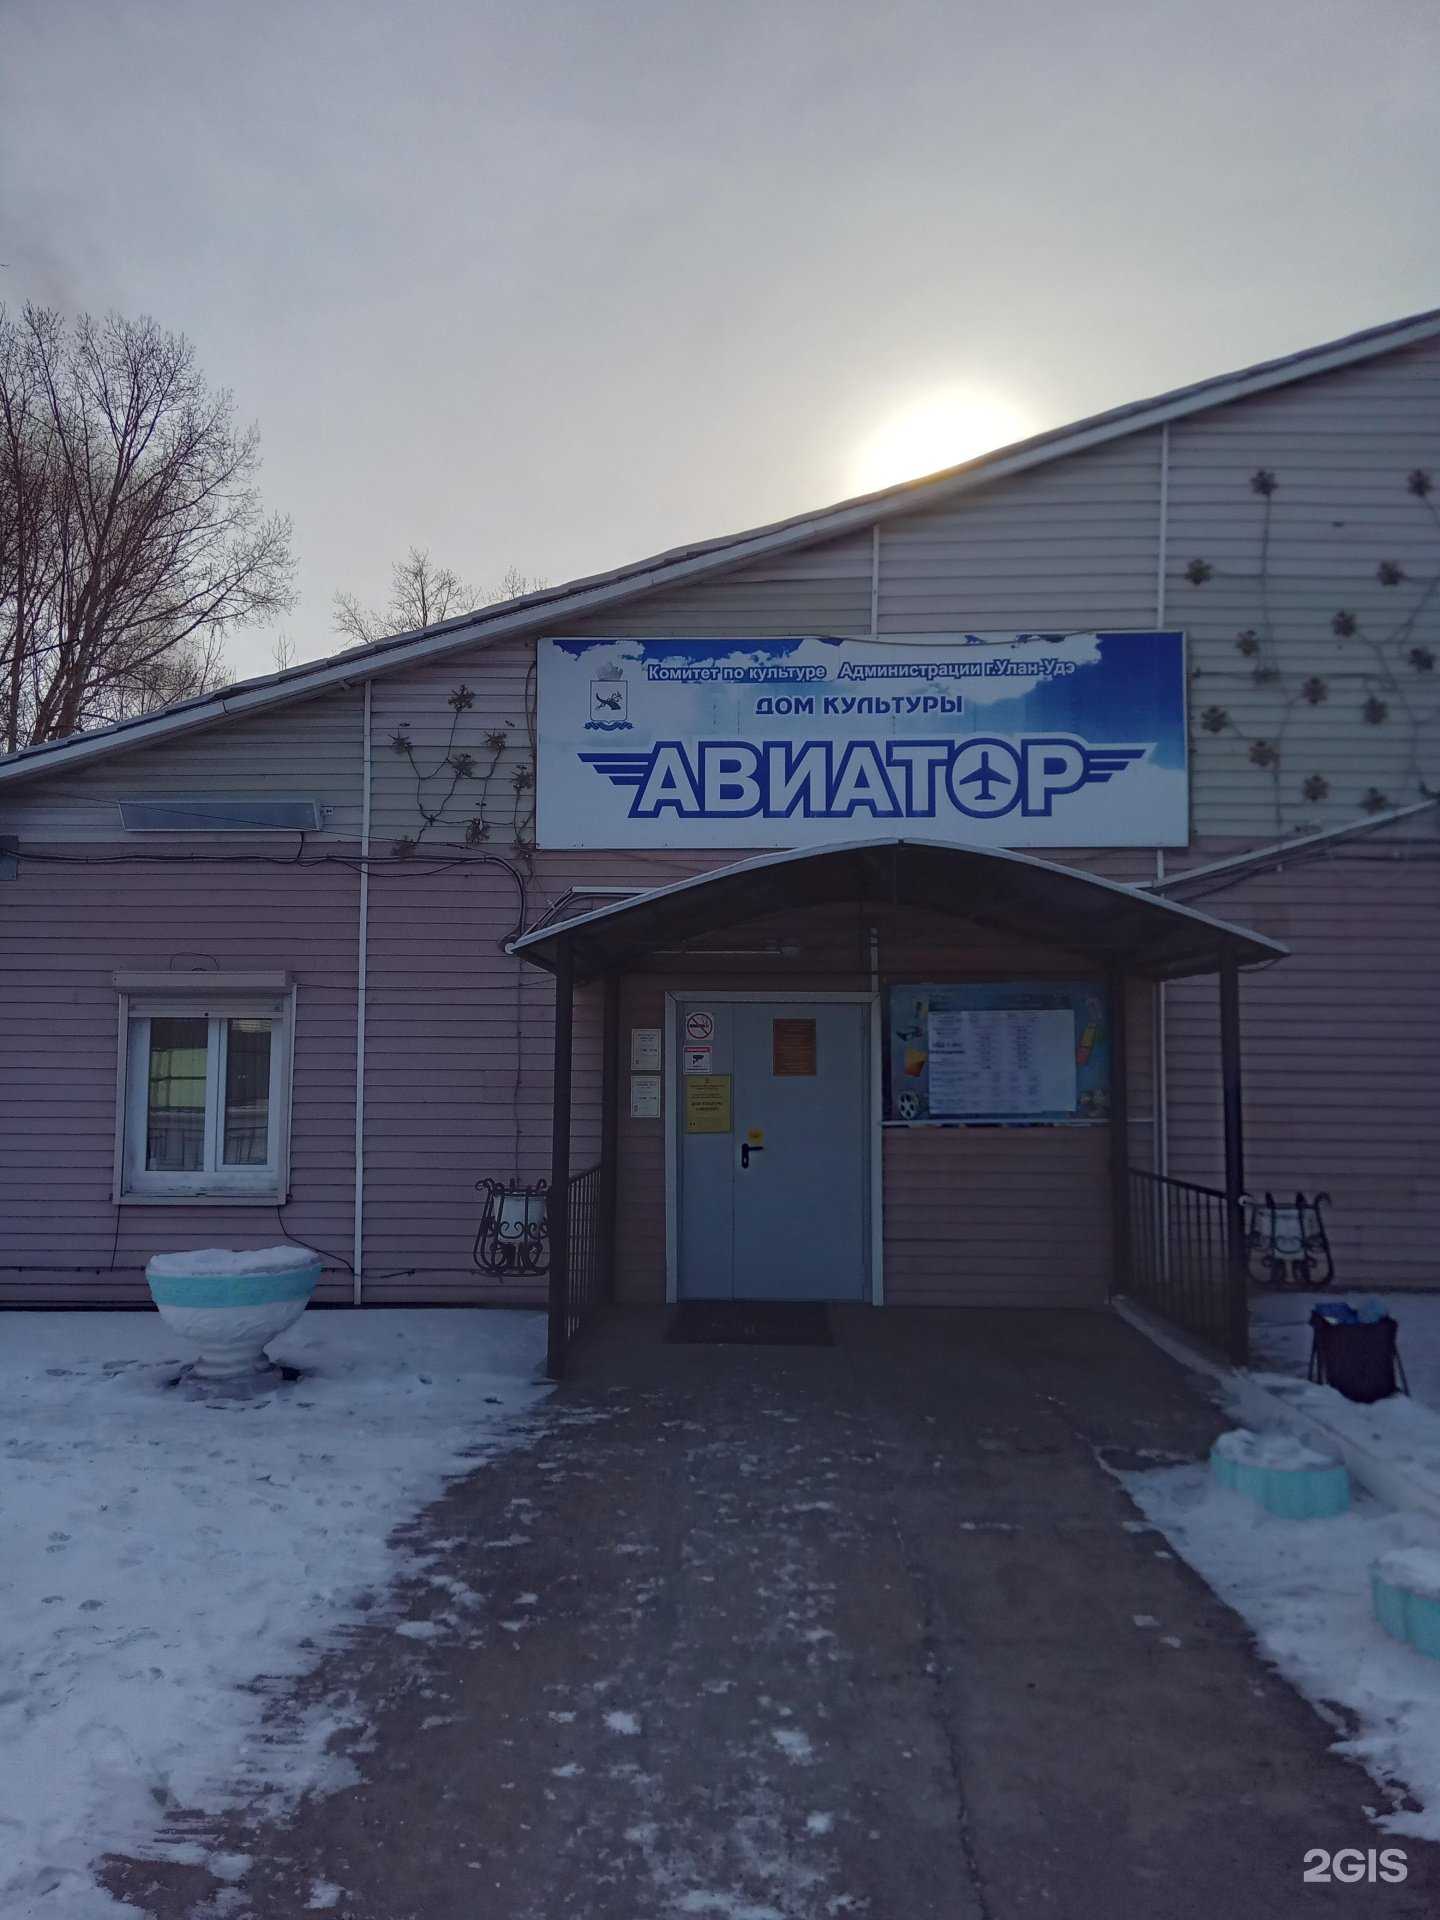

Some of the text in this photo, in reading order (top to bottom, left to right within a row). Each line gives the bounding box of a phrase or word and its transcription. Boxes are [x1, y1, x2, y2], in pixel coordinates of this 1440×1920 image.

[648, 664, 720, 681] Комитет
[722, 667, 746, 681] по
[748, 665, 828, 681] культуре
[837, 662, 981, 681] Администрации
[756, 696, 963, 714] ДОМ КУЛЬТУРЫ
[629, 738, 1090, 819] АВИАТОР
